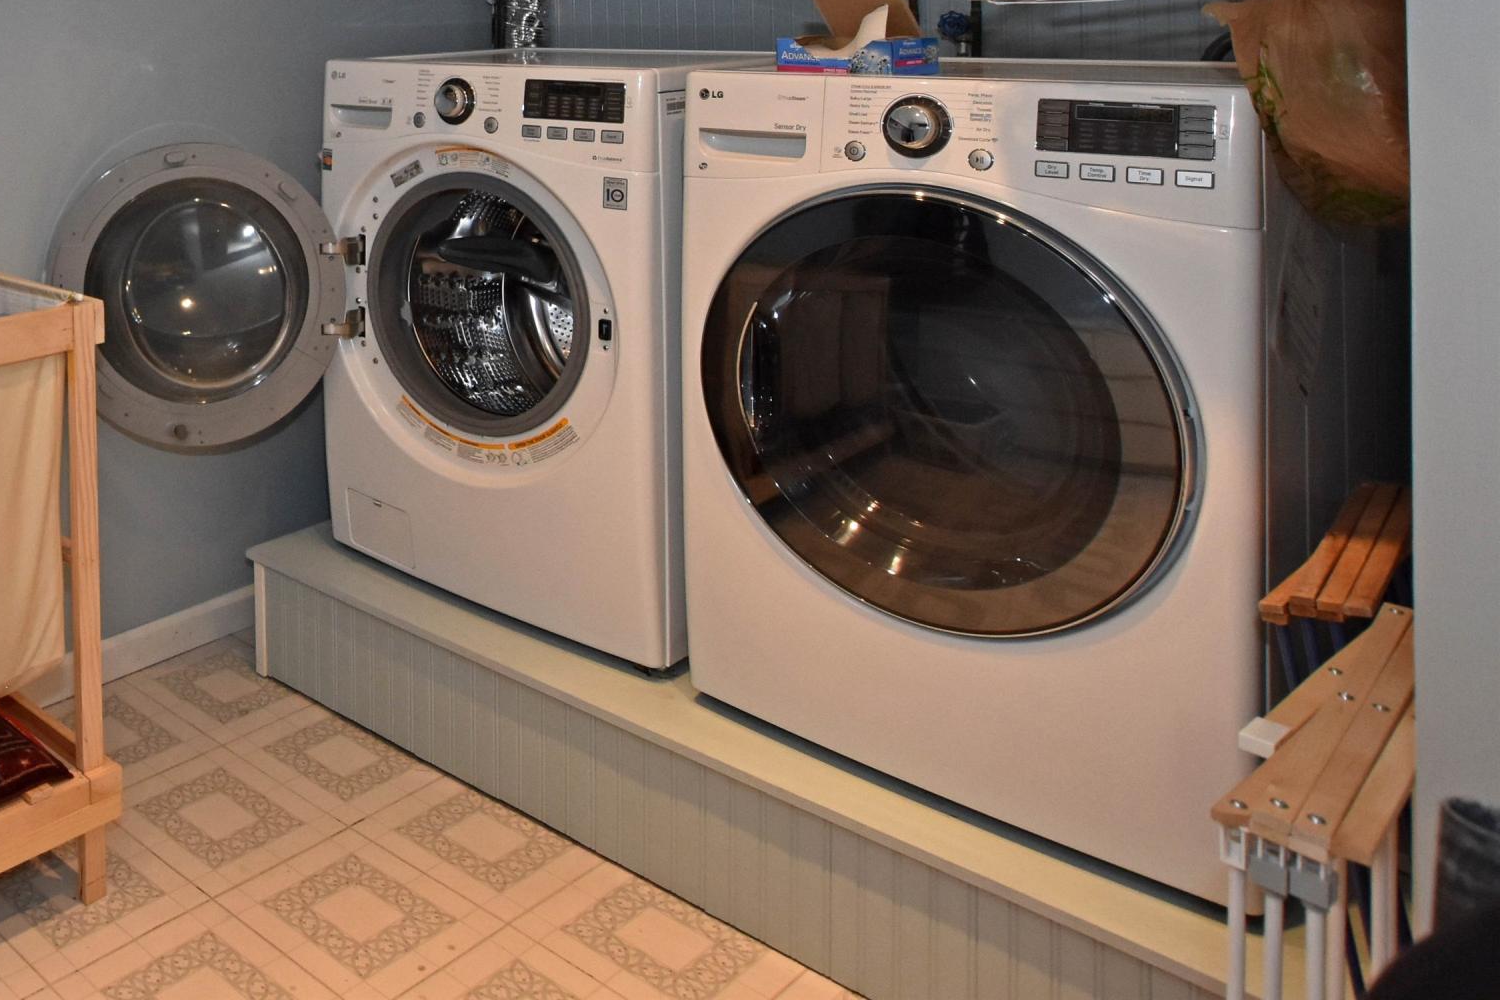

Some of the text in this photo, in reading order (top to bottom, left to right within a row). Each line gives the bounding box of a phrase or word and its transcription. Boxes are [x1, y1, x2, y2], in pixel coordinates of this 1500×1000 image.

[711, 90, 724, 99] LG
[773, 122, 806, 131] Sensor Dry
